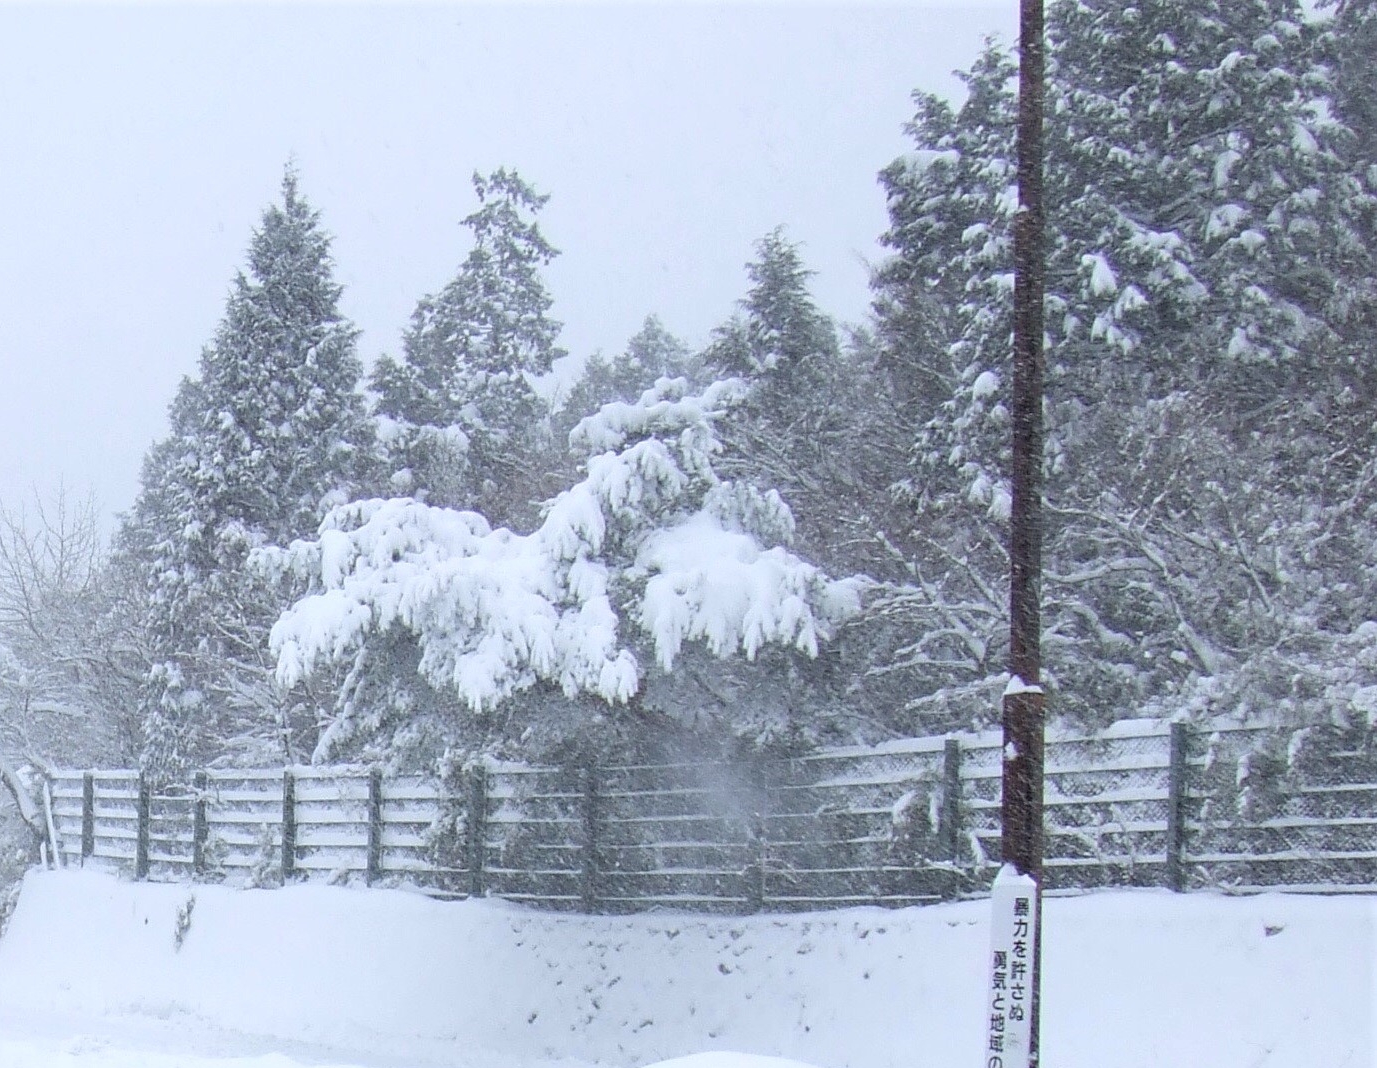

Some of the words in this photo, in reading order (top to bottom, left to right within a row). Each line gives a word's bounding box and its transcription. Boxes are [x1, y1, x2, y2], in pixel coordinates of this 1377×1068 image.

[1009, 897, 1029, 1021] 暴力を許さぬ
